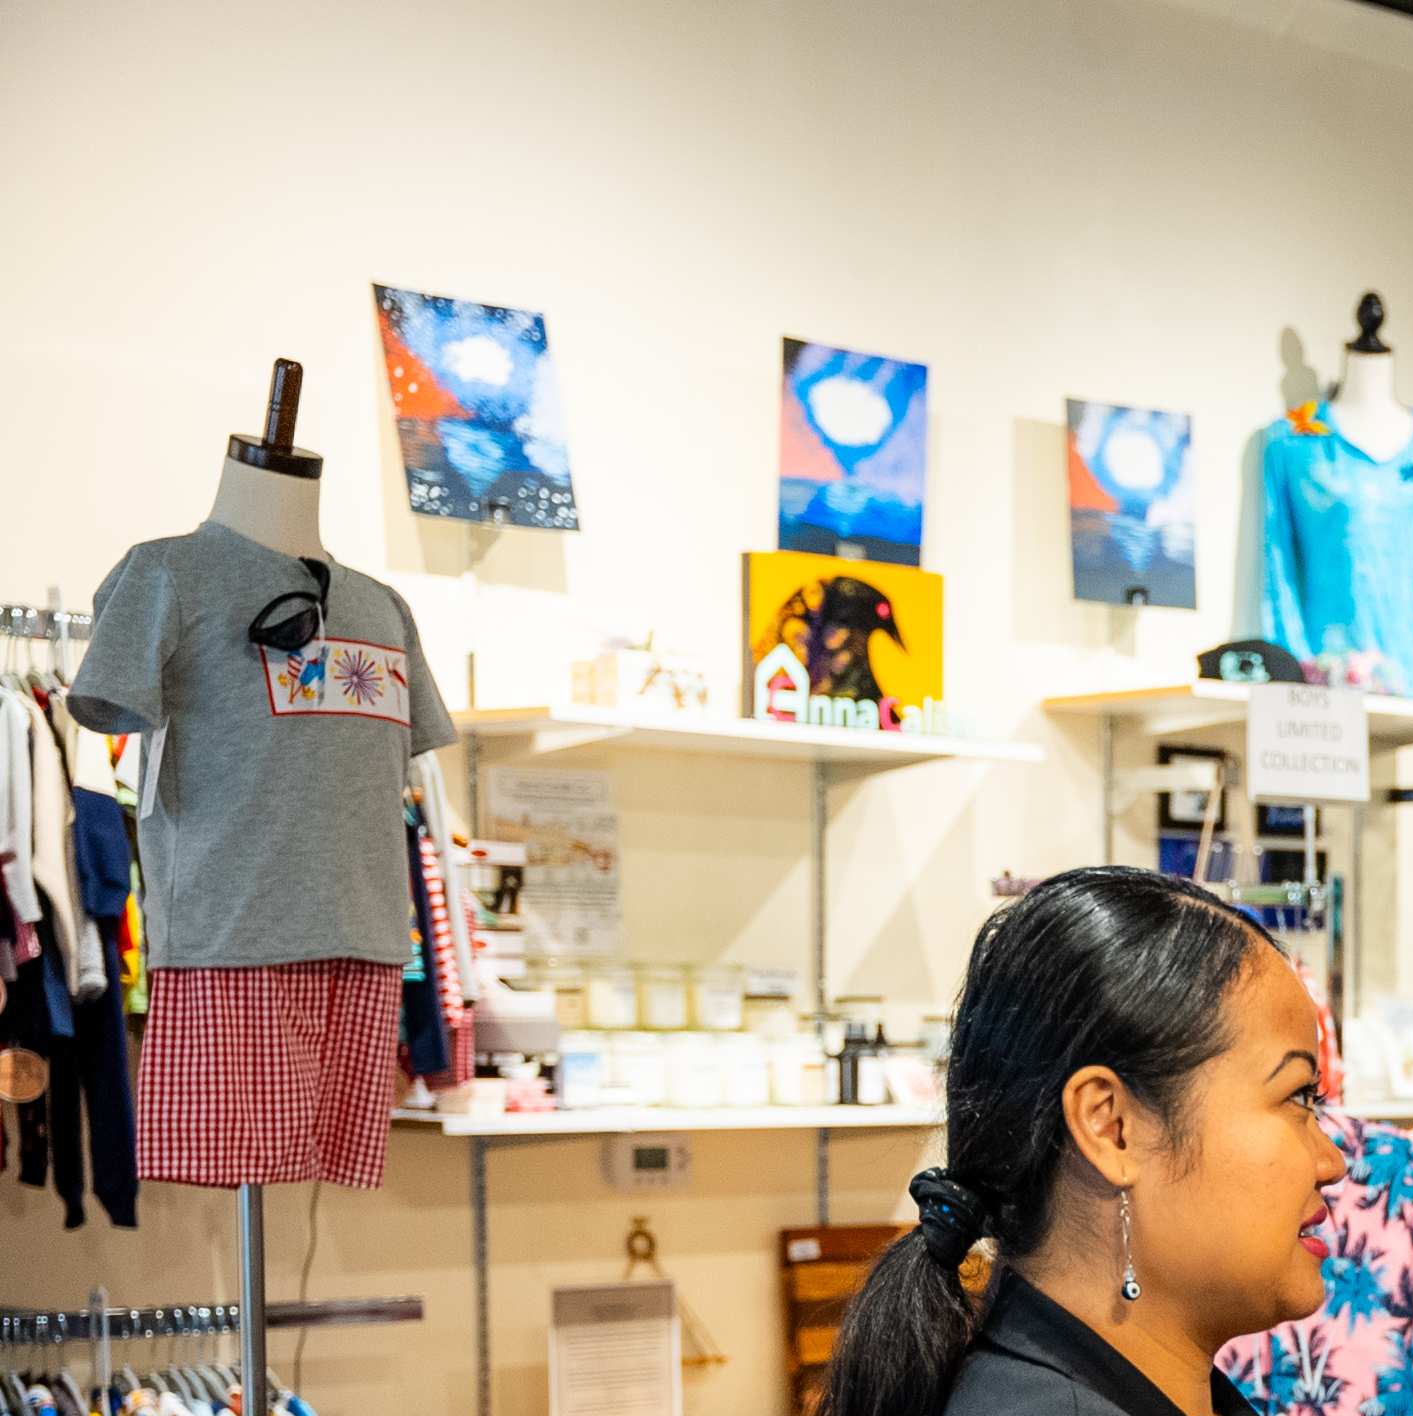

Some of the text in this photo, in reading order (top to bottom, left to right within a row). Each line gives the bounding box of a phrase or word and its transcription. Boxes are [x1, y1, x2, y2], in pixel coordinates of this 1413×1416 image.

[1288, 689, 1330, 709] BOYS
[1275, 721, 1344, 742] LIMITED
[1260, 750, 1360, 774] COLLECTION
